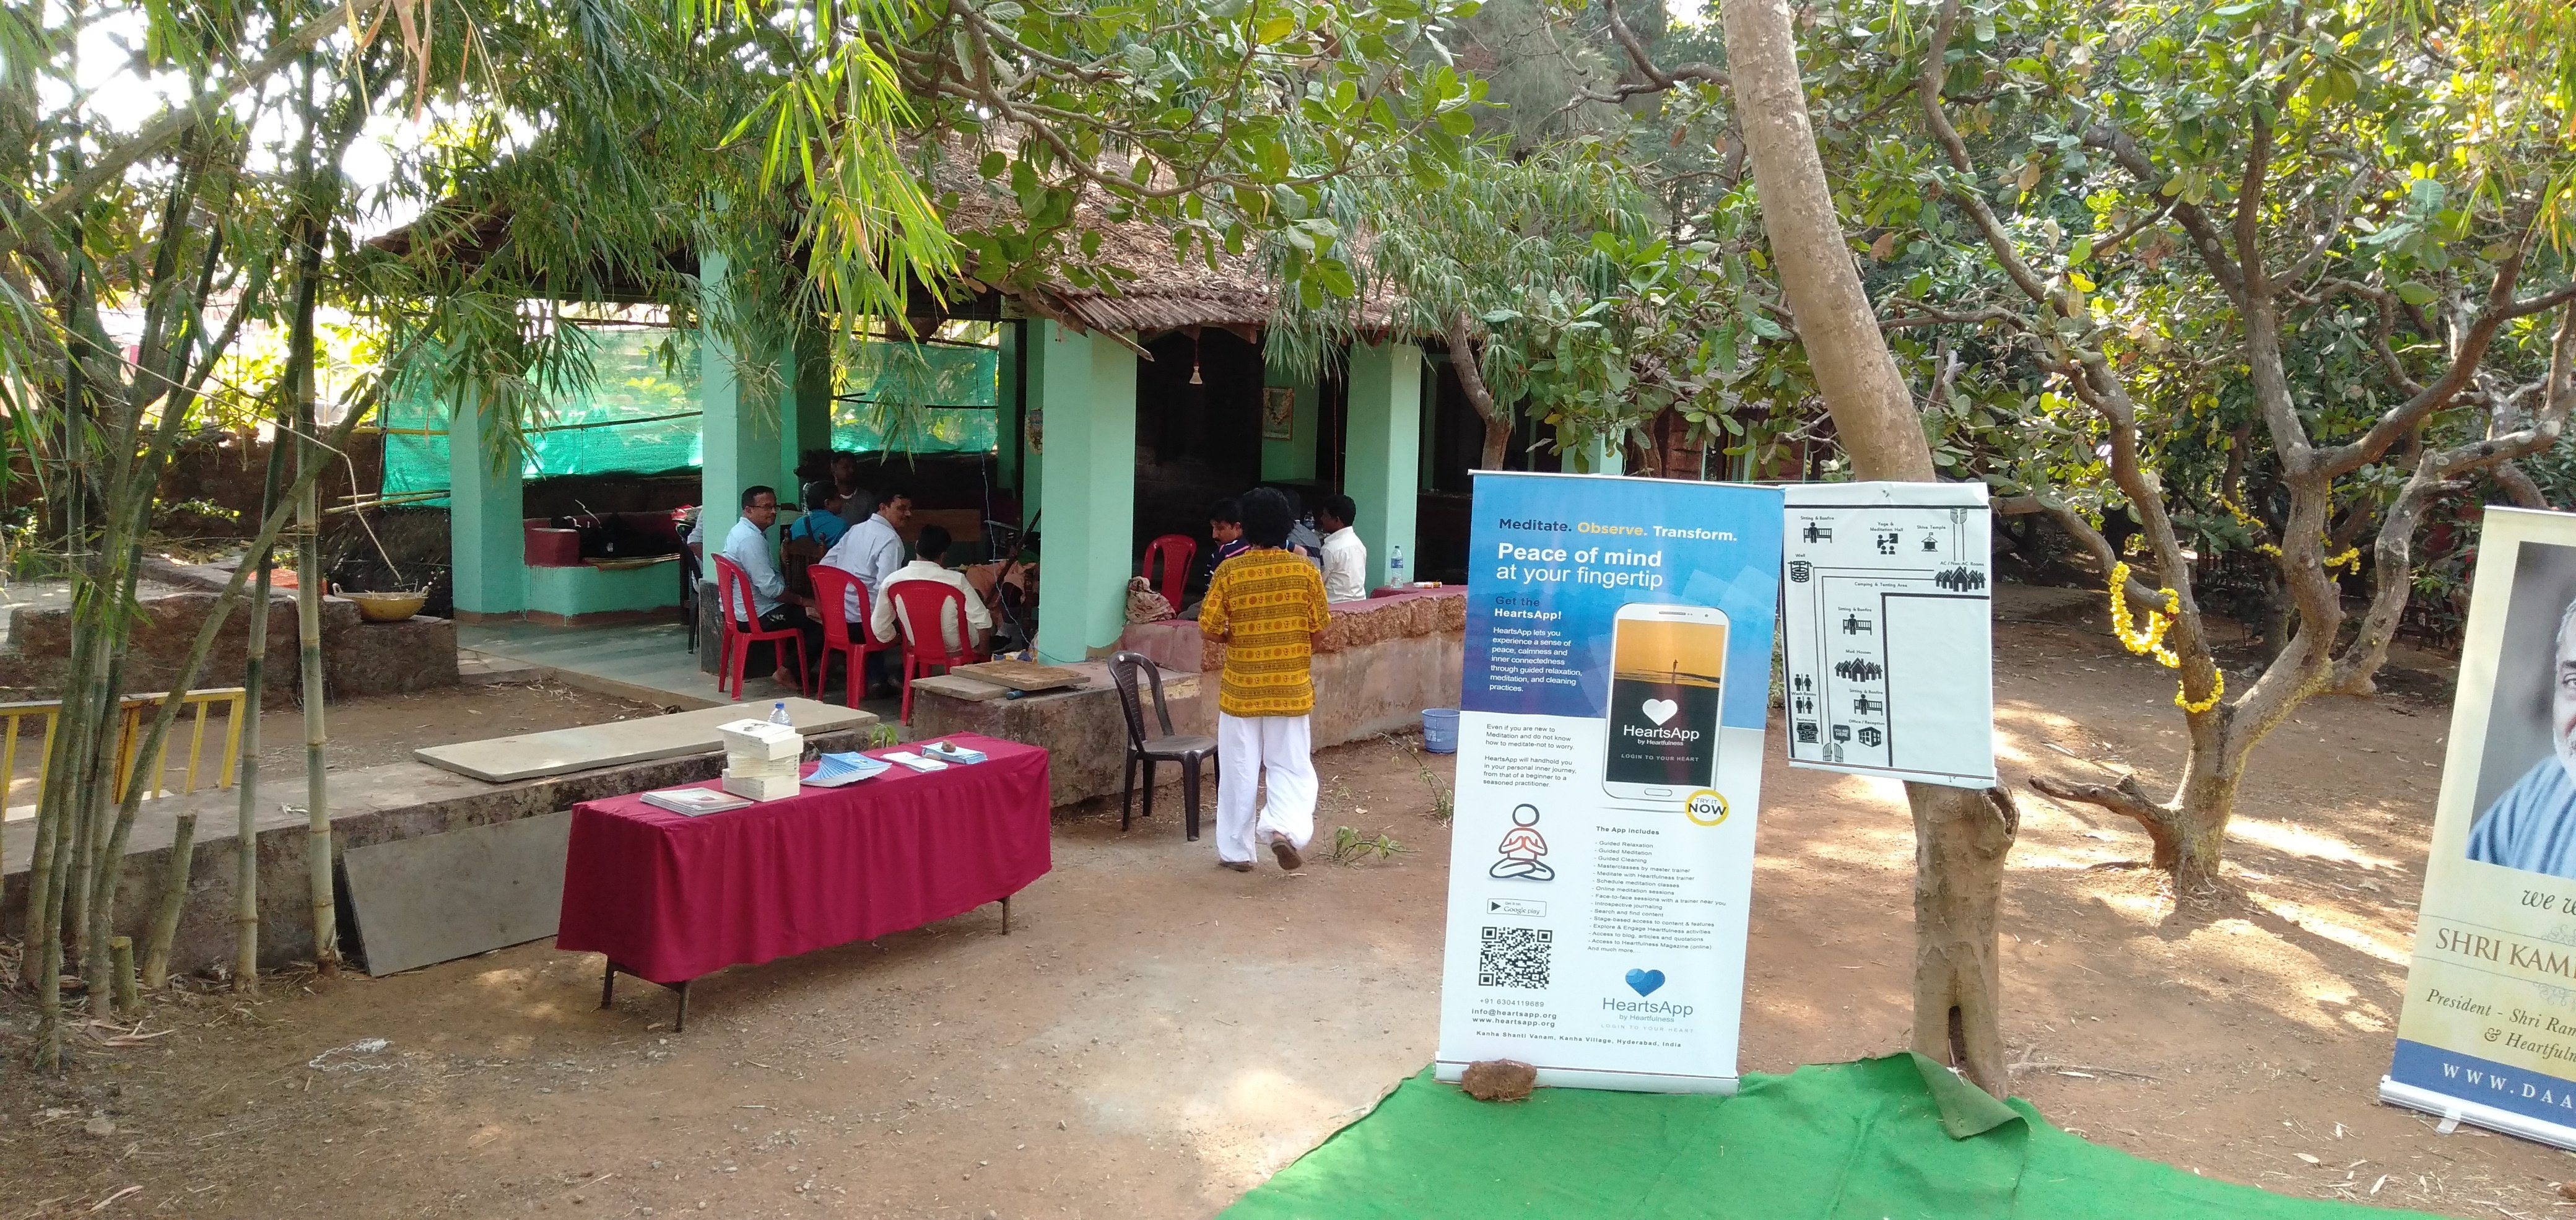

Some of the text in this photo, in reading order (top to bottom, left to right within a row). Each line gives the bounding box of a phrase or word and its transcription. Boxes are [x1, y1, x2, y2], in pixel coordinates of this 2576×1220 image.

[1499, 518, 1737, 541] Meditate. Observe. Transform.
[1498, 542, 1662, 567] Peace of mind
[1496, 564, 1663, 591] at your fingertip
[1495, 596, 1540, 608] Get the
[1494, 608, 1562, 621] HeartsApp!
[1493, 627, 1532, 637] HeartsApp
[1492, 637, 1533, 645] experience
[1491, 655, 1510, 663] inner
[1490, 664, 1518, 674] through
[1520, 666, 1544, 674] guided
[1546, 676, 1577, 686] cleaning
[1624, 725, 1700, 741] HeartsApp
[1484, 755, 1518, 764] HeartsApp
[1688, 803, 1727, 816] NOW
[2522, 890, 2556, 910] we
[2435, 928, 2576, 979] SHRI KAM
[1497, 999, 1544, 1007] 6304119689
[1603, 997, 1693, 1017] HeartsApp
[2426, 988, 2491, 1016] President
[2509, 1008, 2542, 1028] Shri
[1471, 1008, 1557, 1020] info@heartsapp.org
[1630, 1014, 1674, 1022] Heartfulness
[1472, 1017, 1555, 1028] www.heartsapp.org
[2484, 1027, 2502, 1042] &
